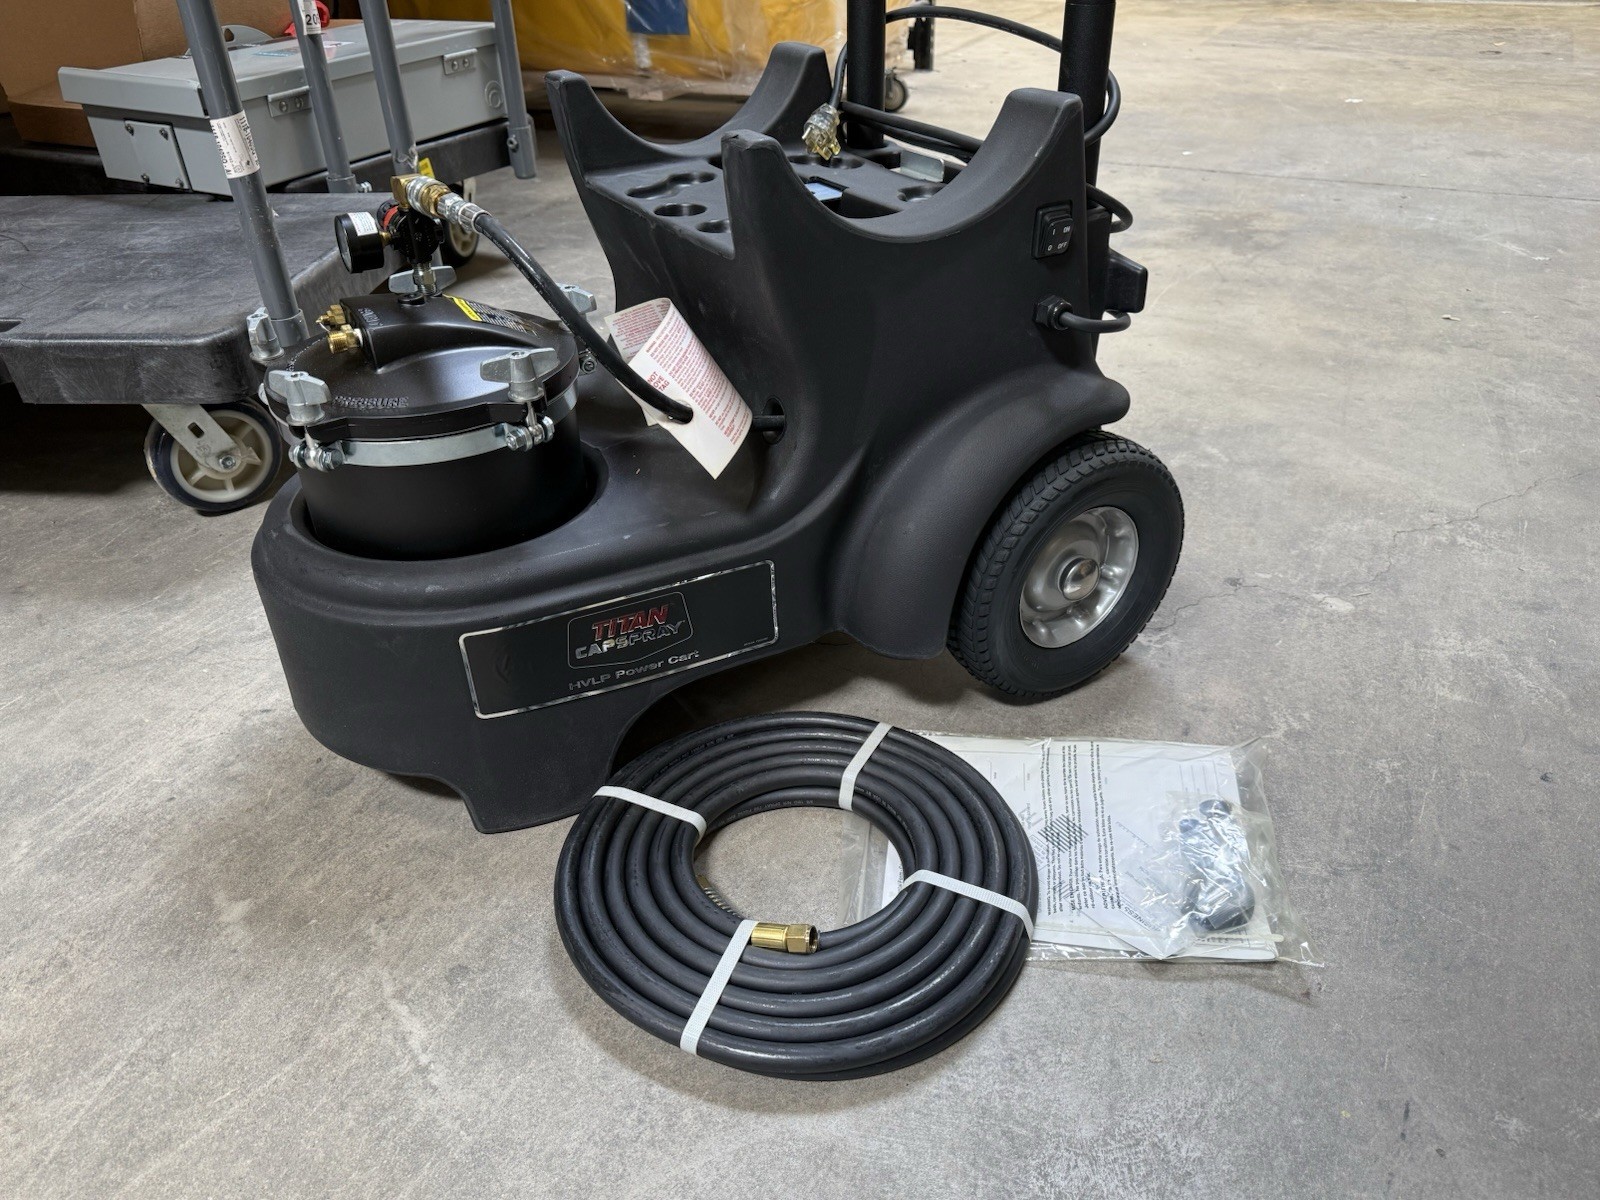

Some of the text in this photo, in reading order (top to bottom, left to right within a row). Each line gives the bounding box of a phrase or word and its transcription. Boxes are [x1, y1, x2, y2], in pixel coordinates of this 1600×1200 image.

[1057, 241, 1068, 249] OFF
[653, 375, 664, 388] OVE
[658, 379, 670, 392] TAG
[592, 604, 669, 642] TITAN
[574, 619, 684, 660] CAPSPRAY
[569, 649, 700, 691] HVLP Power Cart
